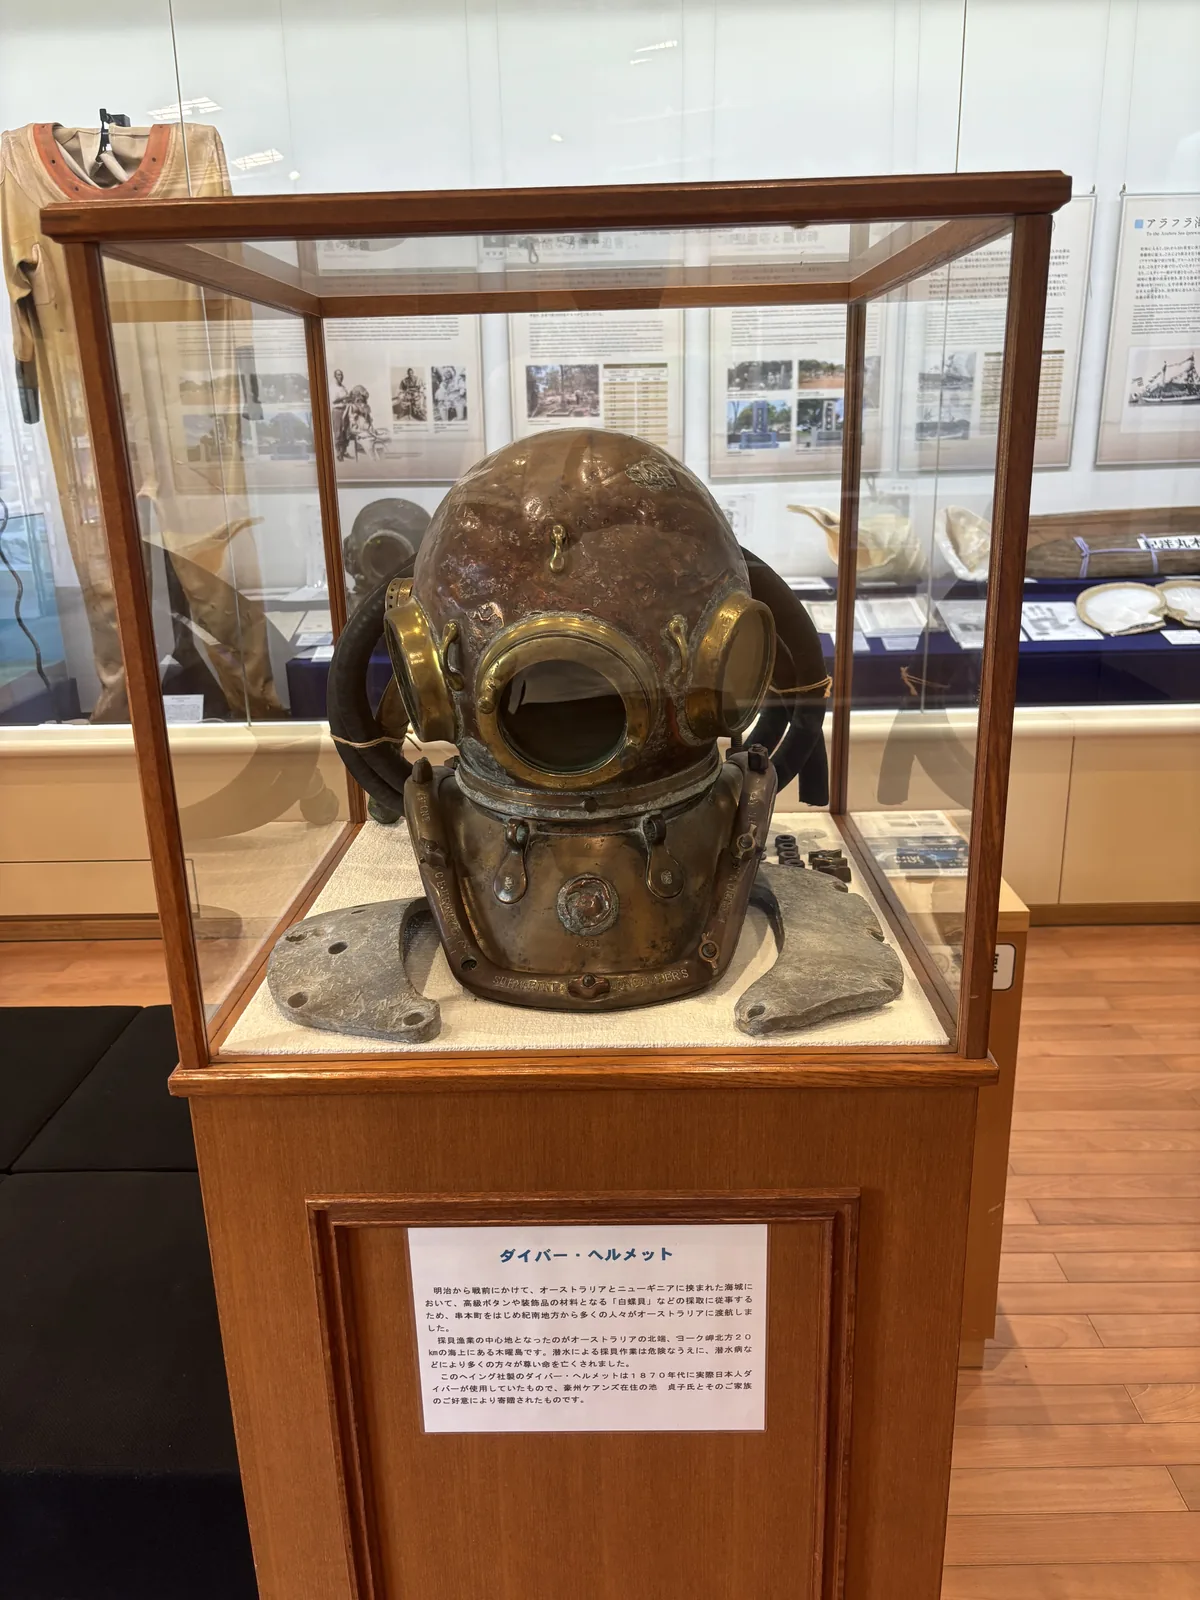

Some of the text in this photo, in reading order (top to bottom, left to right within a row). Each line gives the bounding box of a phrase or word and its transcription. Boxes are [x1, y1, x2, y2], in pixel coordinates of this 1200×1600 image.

[499, 1247, 673, 1263] ダイバー・ヘルメット
[428, 1324, 450, 1333] した。
[430, 1359, 631, 1369] どにより多くの方々が尊い命を亡くされました。
